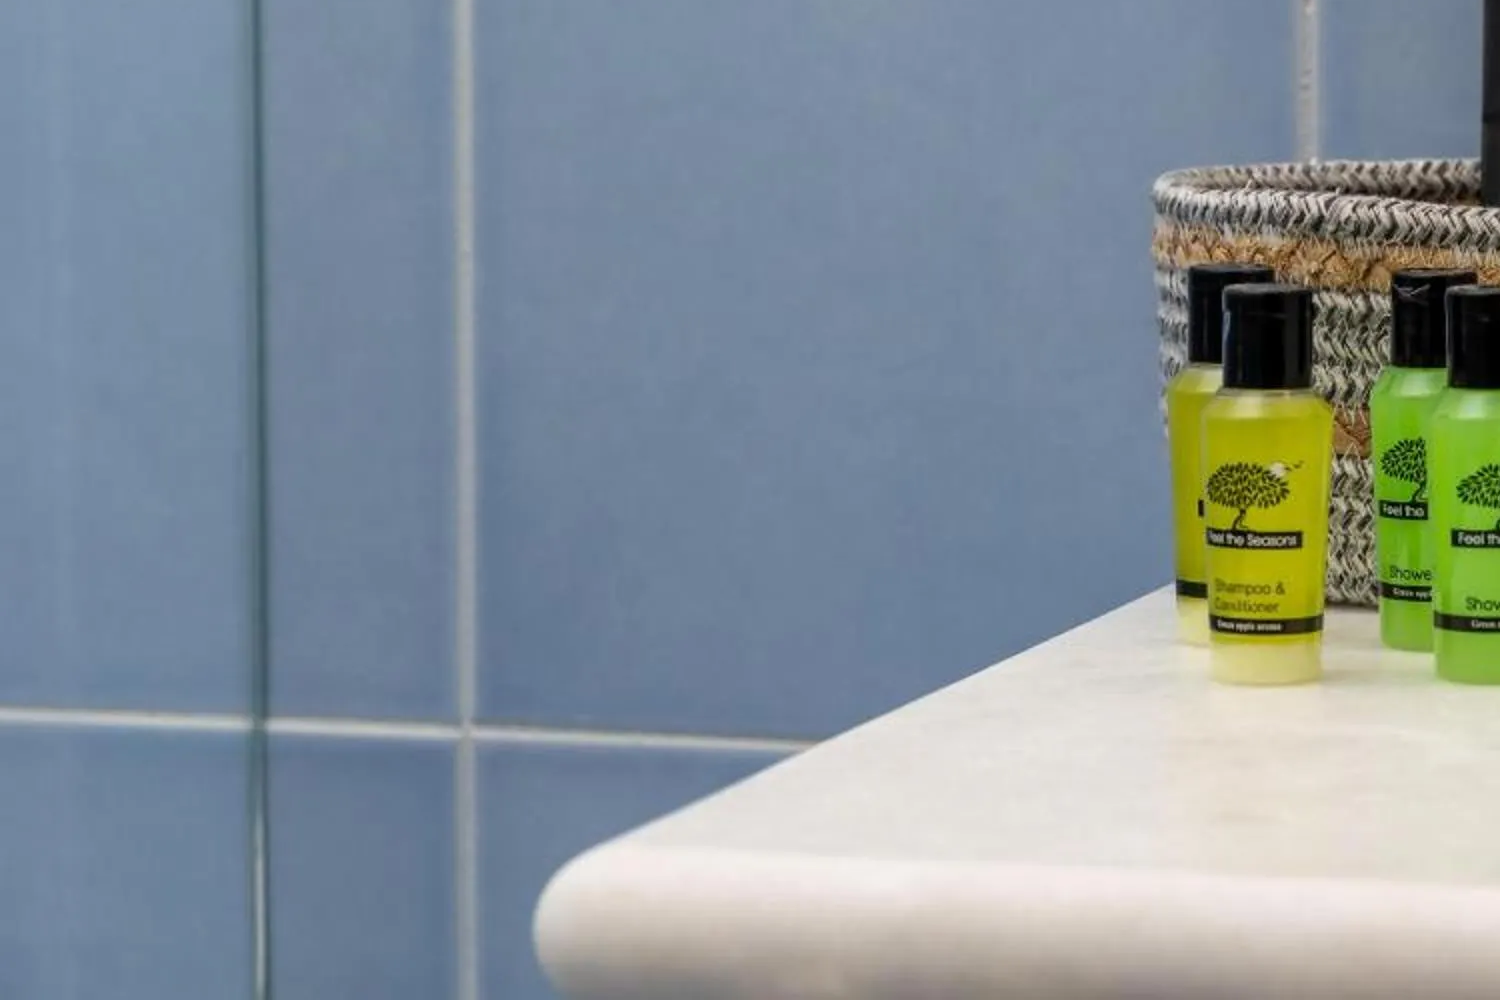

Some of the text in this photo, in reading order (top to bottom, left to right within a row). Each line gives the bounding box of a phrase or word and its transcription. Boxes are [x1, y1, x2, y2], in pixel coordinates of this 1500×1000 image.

[1246, 533, 1298, 547] Seasons
[1457, 532, 1485, 545] Feel
[1389, 565, 1432, 581] Showe
[1214, 578, 1286, 596] Shampoo &
[1214, 597, 1280, 614] Conditioner
